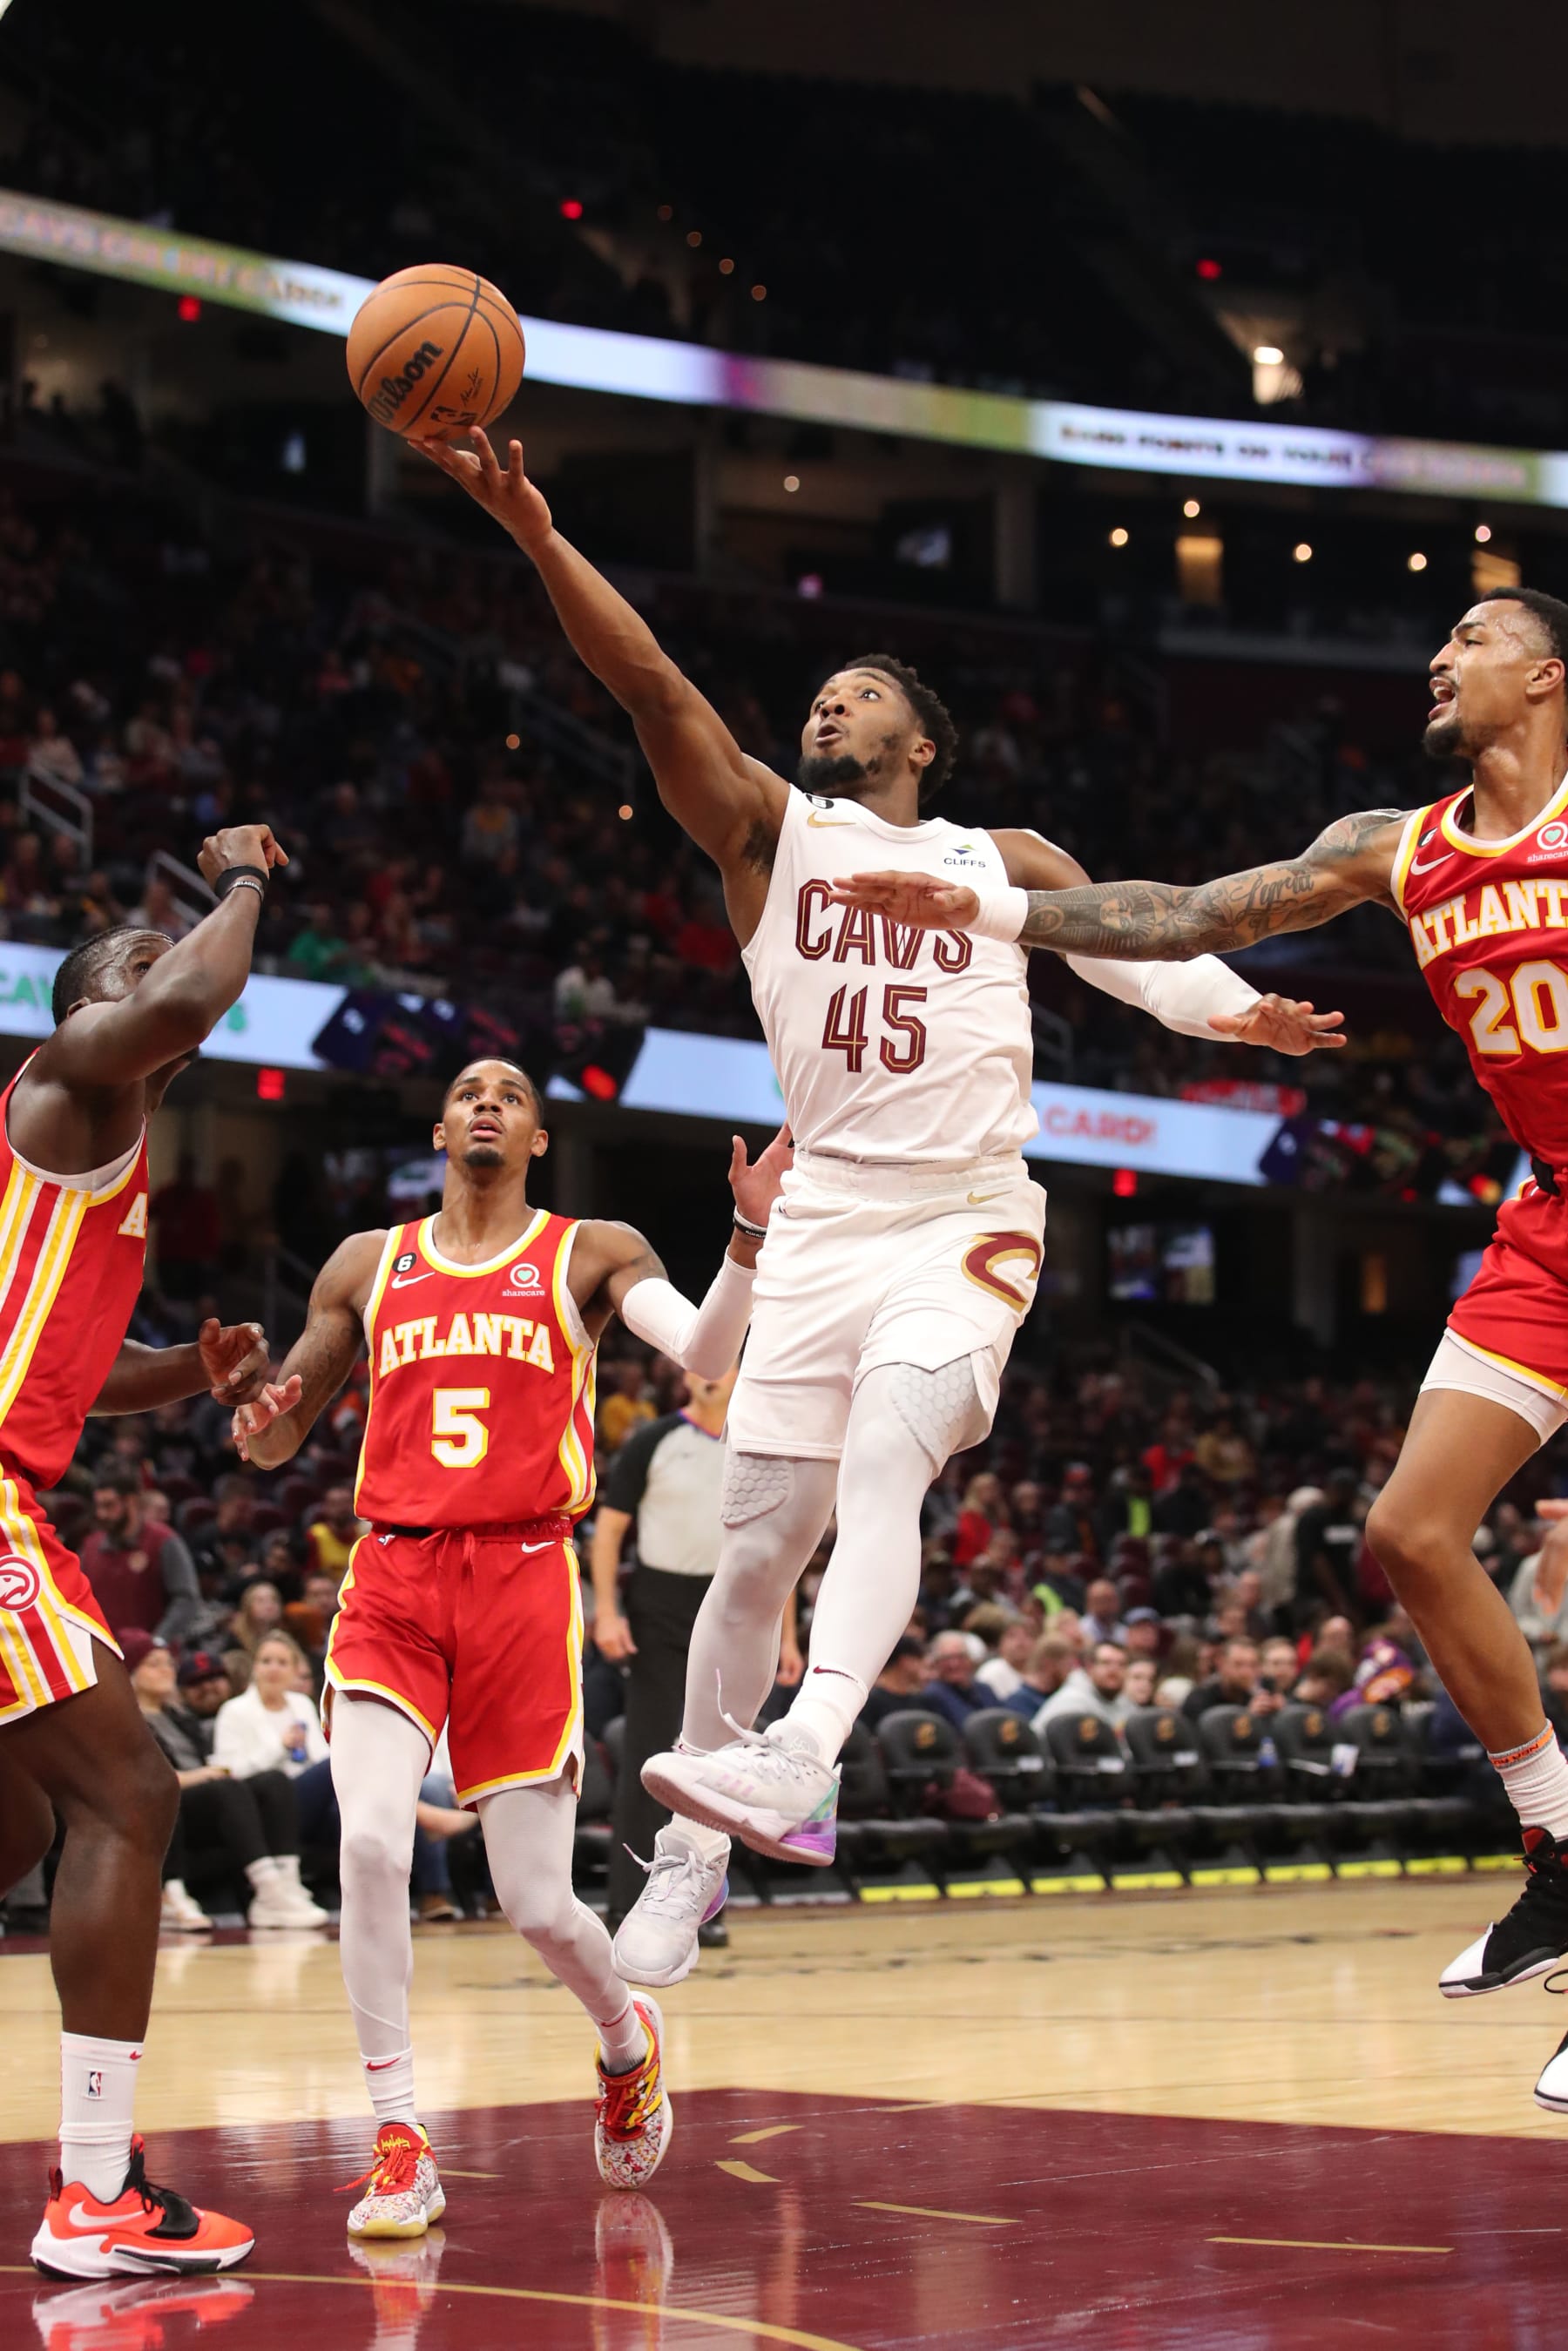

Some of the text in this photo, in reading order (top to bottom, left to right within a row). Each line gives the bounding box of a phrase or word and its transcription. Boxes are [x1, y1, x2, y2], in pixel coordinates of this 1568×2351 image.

[368, 340, 444, 424] Wilson
[943, 857, 986, 868] CLIFFS
[795, 878, 973, 974] CAVS
[1409, 878, 1568, 970] ATLANT
[821, 983, 927, 1074] 45
[1453, 959, 1568, 1055] 20
[397, 1254, 412, 1272] 6
[379, 1312, 555, 1379] ATLANTA
[431, 1387, 490, 1468] 5
